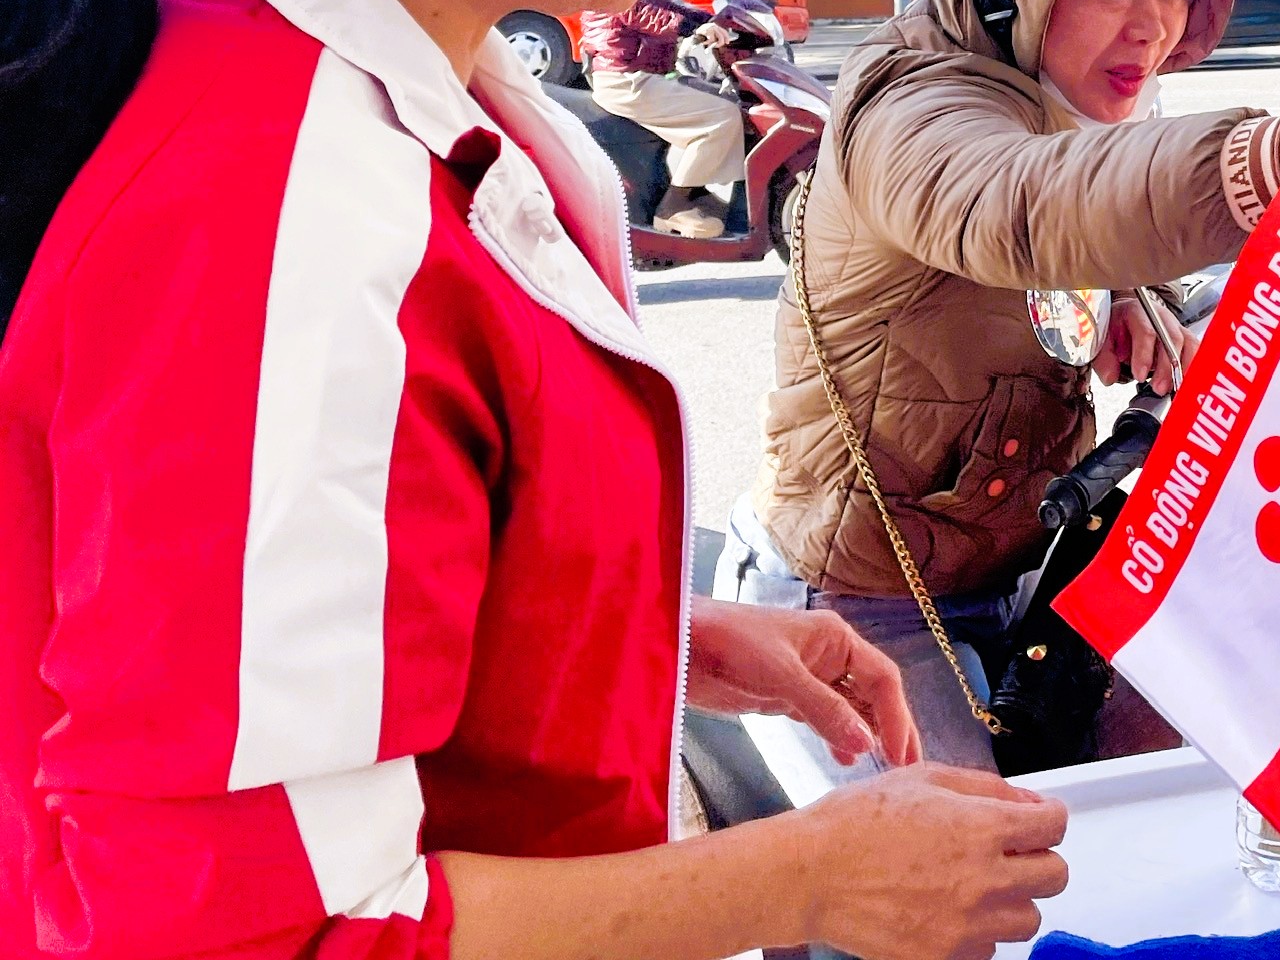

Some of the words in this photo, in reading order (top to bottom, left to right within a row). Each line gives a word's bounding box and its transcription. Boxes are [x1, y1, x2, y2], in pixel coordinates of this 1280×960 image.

[1121, 524, 1164, 594] CỔ
[1146, 451, 1210, 550] ĐỘNG
[1186, 372, 1247, 457] VIÊN
